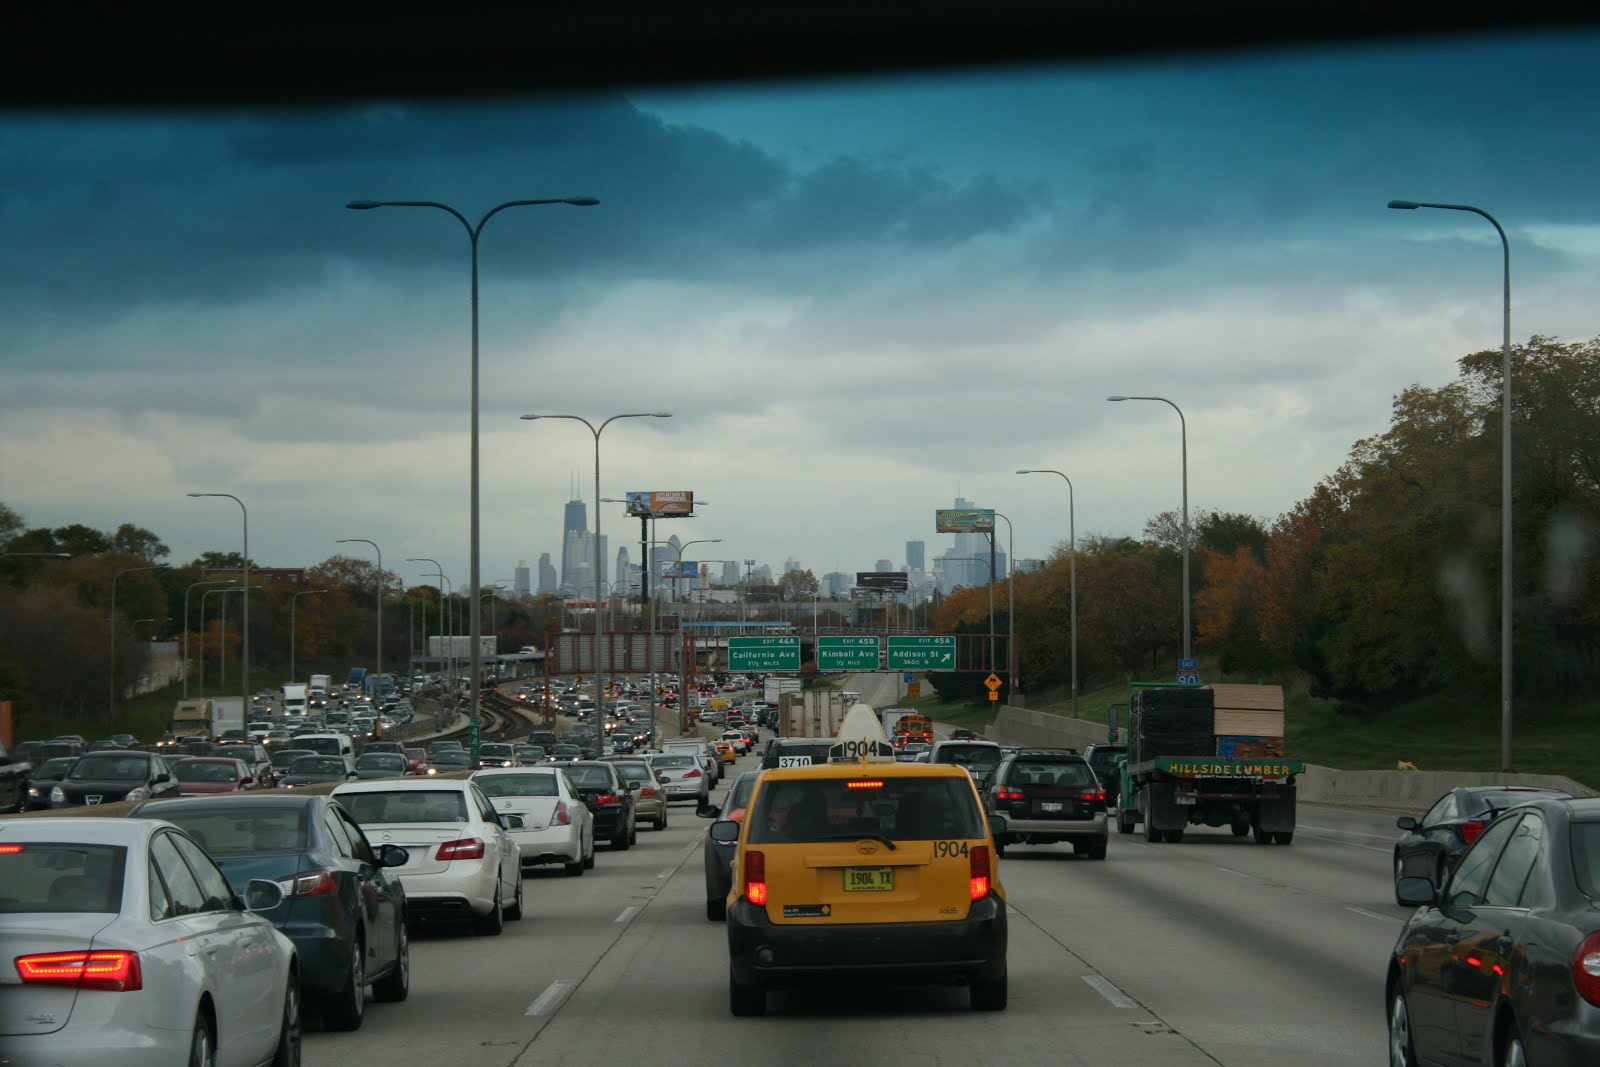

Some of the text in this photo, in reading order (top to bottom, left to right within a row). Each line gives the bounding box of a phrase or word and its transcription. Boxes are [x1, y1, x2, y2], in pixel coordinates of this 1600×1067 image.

[1178, 675, 1196, 685] 90
[844, 740, 878, 757] 1904
[781, 758, 809, 768] 3710
[1169, 763, 1290, 775] HILLSIDE LUMBER
[934, 841, 969, 858] 1904
[850, 871, 891, 885] 1904 TX
